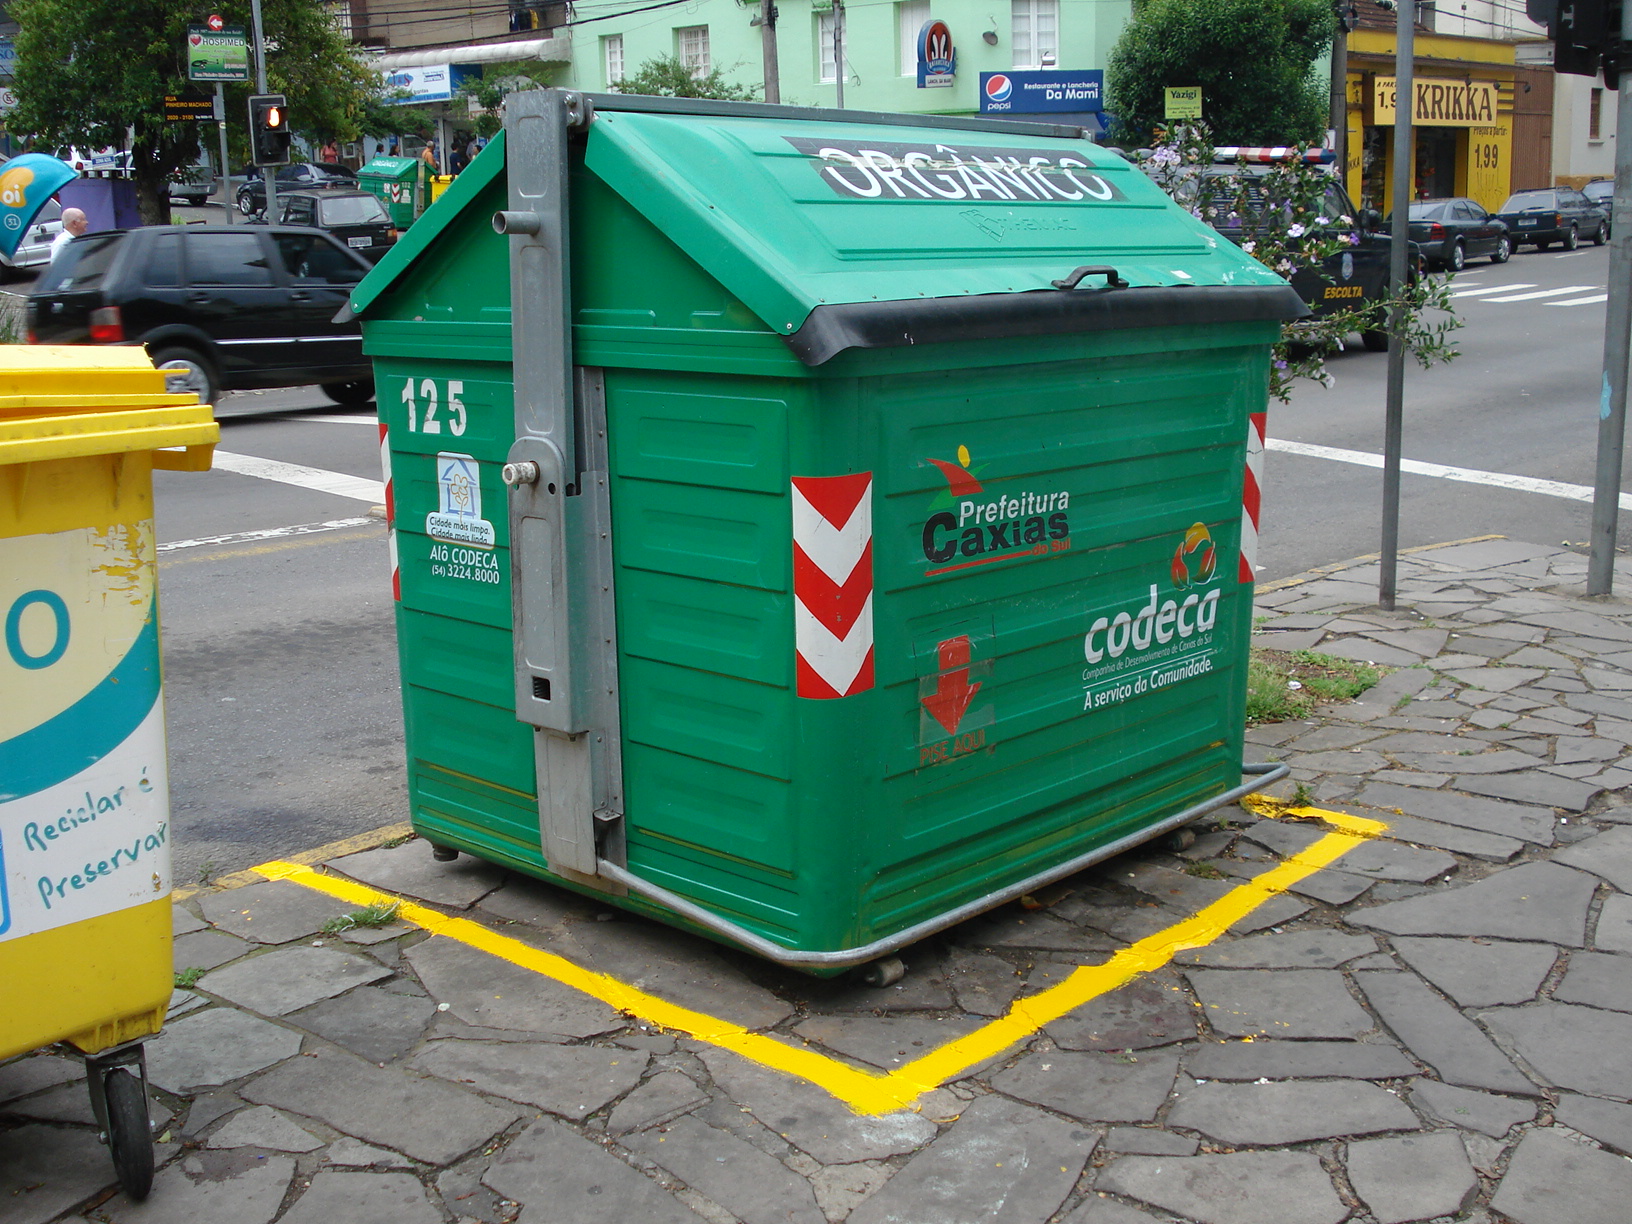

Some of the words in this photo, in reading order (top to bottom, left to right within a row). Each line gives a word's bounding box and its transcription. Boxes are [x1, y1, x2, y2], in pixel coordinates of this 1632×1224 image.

[202, 38, 245, 47] HOSPIMED
[1024, 82, 1060, 90] Restaurante
[1067, 81, 1099, 89] Lancheria
[1046, 89, 1062, 100] Da
[1065, 88, 1099, 100] Mami
[987, 101, 1012, 111] pepsi
[1416, 83, 1493, 122] KRIKKA
[1475, 143, 1499, 169] 1,99
[818, 143, 1113, 200] ORGÂNICO
[2, 184, 20, 204] oi
[7, 218, 18, 226] 31
[1323, 286, 1363, 299] ESCOLTA
[401, 377, 467, 437] 125
[959, 490, 1070, 528] Prefeitura
[429, 516, 452, 529] Cidade
[453, 521, 469, 531] mais
[469, 521, 491, 535] limpa.
[430, 527, 453, 540] Cidade
[454, 532, 470, 542] mais
[922, 511, 1069, 564] Caxias
[429, 545, 449, 562] Alô
[451, 548, 499, 570] CODECA
[1031, 543, 1048, 556] do
[1051, 537, 1071, 553] Sul
[431, 564, 446, 578] (54)
[447, 563, 500, 585] 3224.8000
[1084, 583, 1221, 665] codeca
[1082, 662, 1116, 681] Companhia
[1116, 659, 1124, 671] de
[1124, 648, 1171, 668] Desenvolvimento
[1171, 645, 1178, 655] de
[1178, 639, 1196, 652] Caxias
[1196, 637, 1203, 646] do
[1203, 633, 1213, 645] Sul
[1083, 690, 1092, 711] A
[1094, 682, 1132, 707] serviço
[1134, 675, 1147, 694] da
[1150, 655, 1213, 689] Comunidade.
[919, 740, 949, 767] PISE
[952, 728, 986, 756] AQUI
[23, 785, 125, 853] Reciclar
[138, 765, 154, 794] é
[37, 821, 168, 910] Preservar
